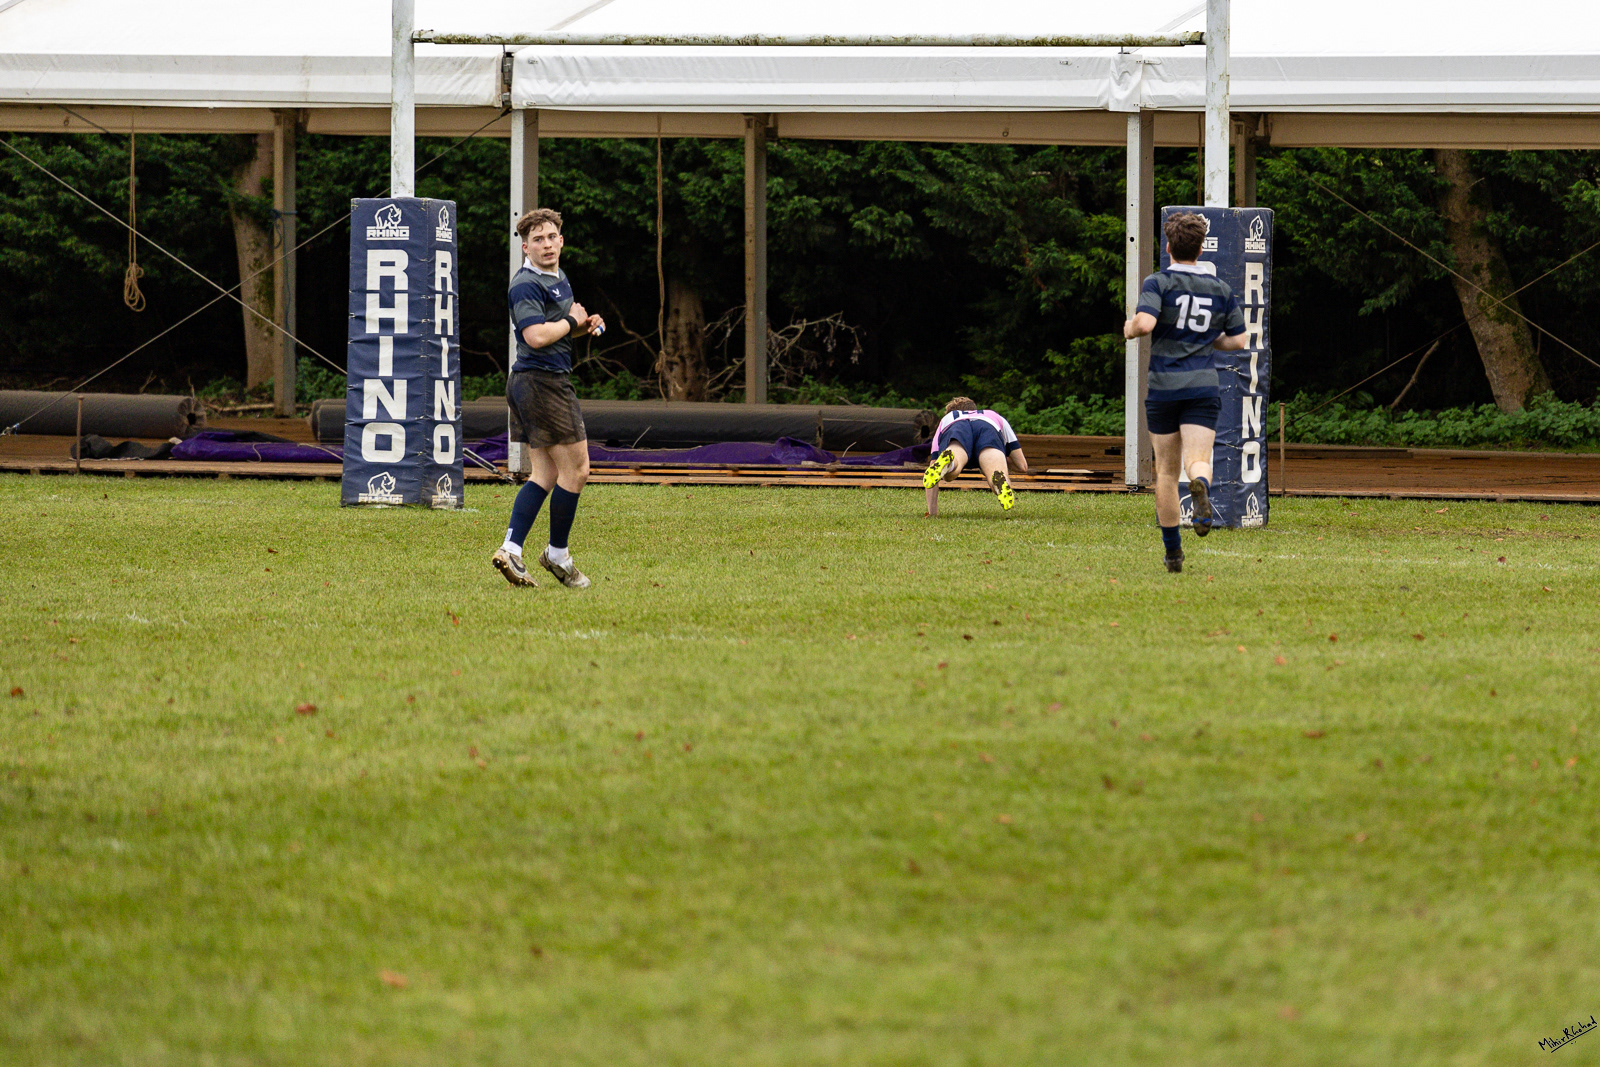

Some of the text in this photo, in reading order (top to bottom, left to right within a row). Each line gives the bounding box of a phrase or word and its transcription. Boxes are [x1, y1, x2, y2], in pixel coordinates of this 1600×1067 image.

[366, 229, 409, 238] RHINO
[1244, 241, 1266, 250] RHINO
[361, 249, 409, 464] RHINO
[432, 249, 456, 465] RHINO
[1175, 294, 1213, 333] 15
[1241, 261, 1265, 484] RHINO
